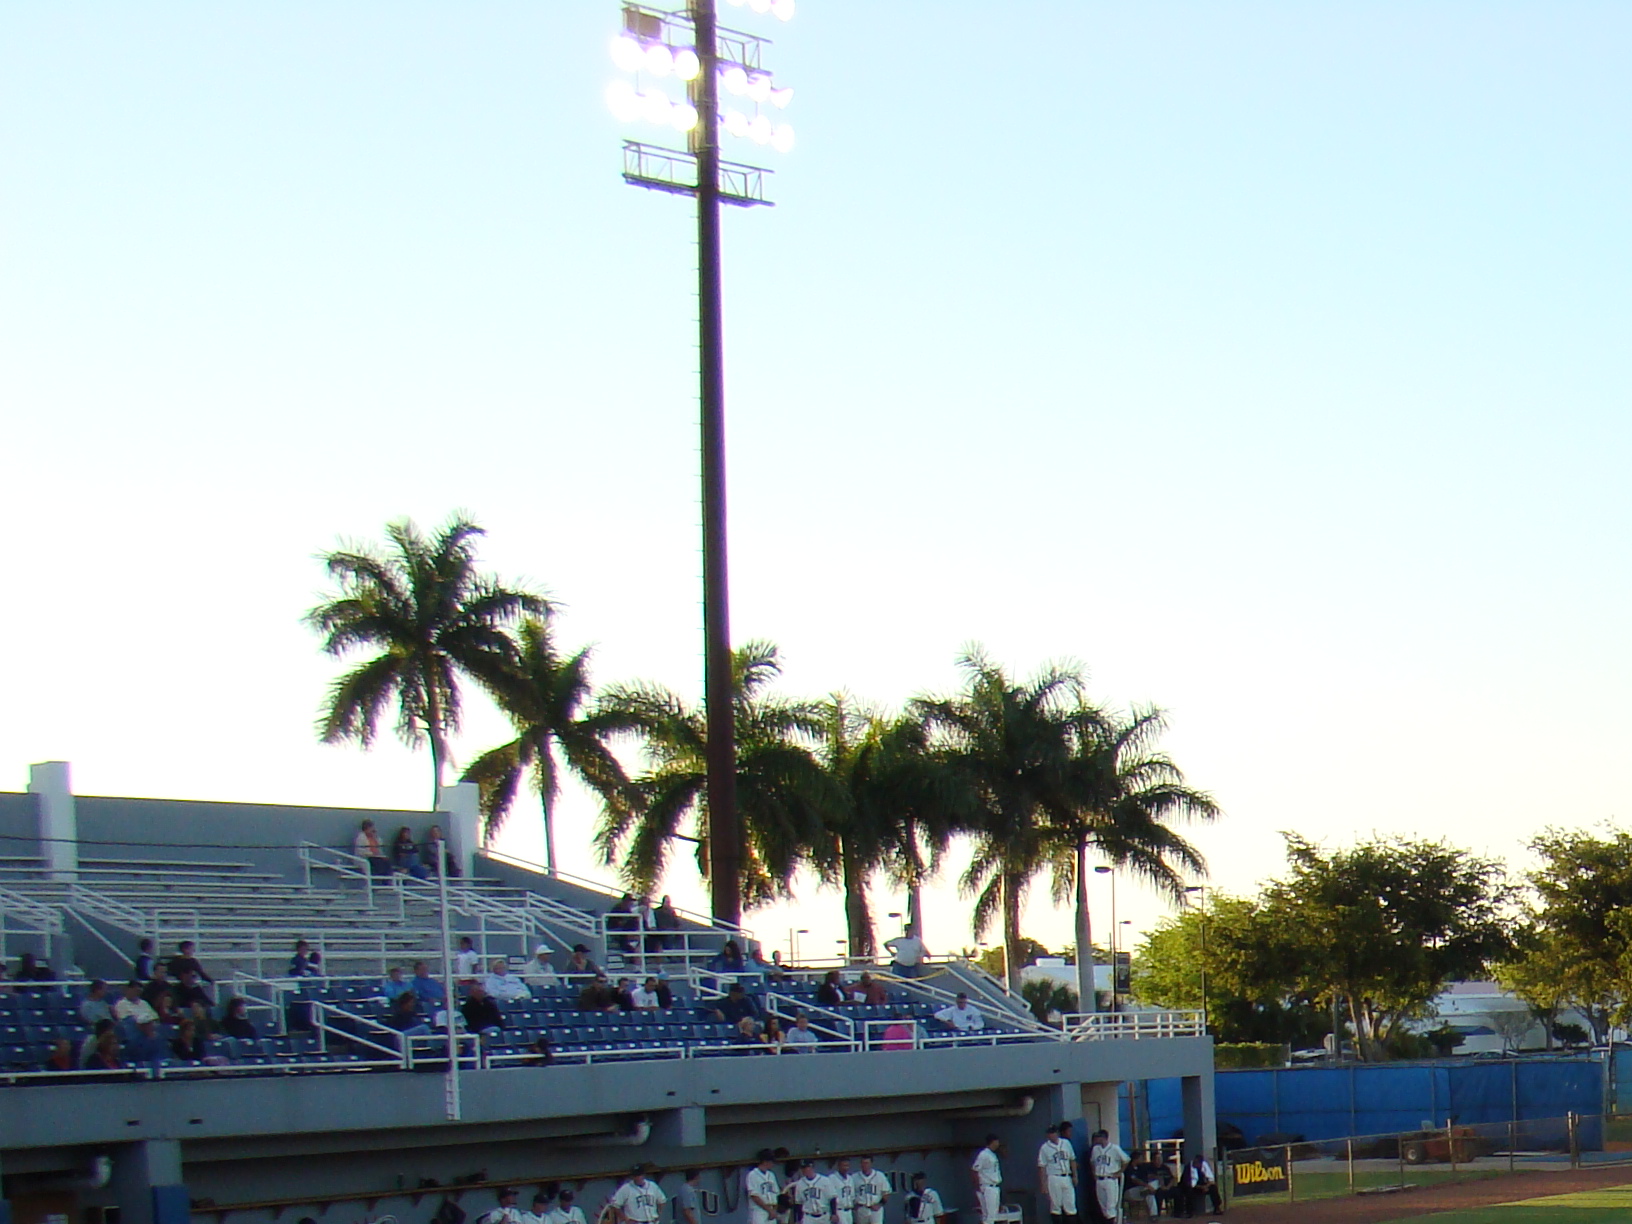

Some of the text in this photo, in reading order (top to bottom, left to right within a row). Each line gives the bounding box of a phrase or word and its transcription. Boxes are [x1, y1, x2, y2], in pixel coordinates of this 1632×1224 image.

[1236, 1160, 1285, 1185] Wilson
[804, 1187, 821, 1201] FIU
[859, 1183, 877, 1195] FIU
[636, 1194, 655, 1208] FIU
